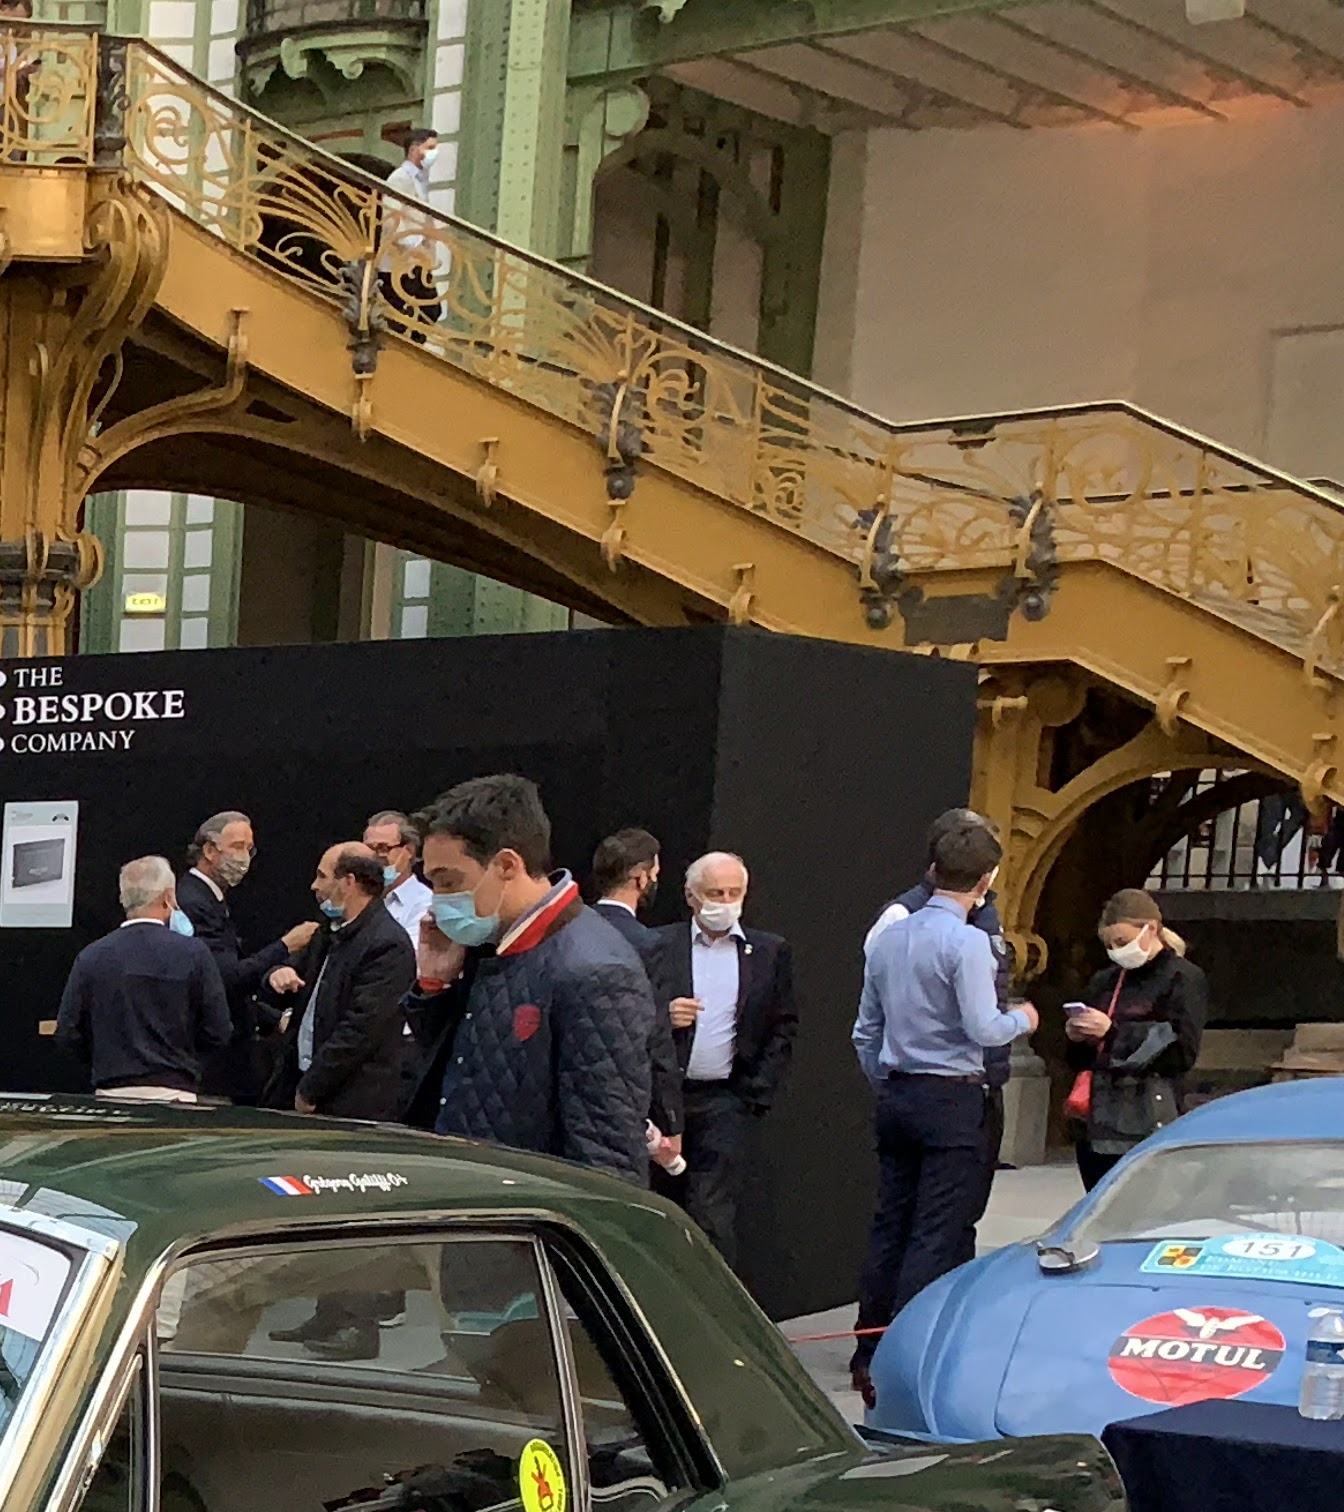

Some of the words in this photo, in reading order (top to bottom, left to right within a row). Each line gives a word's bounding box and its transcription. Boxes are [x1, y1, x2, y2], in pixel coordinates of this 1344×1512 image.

[13, 666, 64, 688] THE
[12, 689, 185, 726] BESPOKE
[11, 729, 136, 754] COMPANY
[1244, 1241, 1303, 1258] 151
[1120, 1338, 1266, 1370] MOTUL
